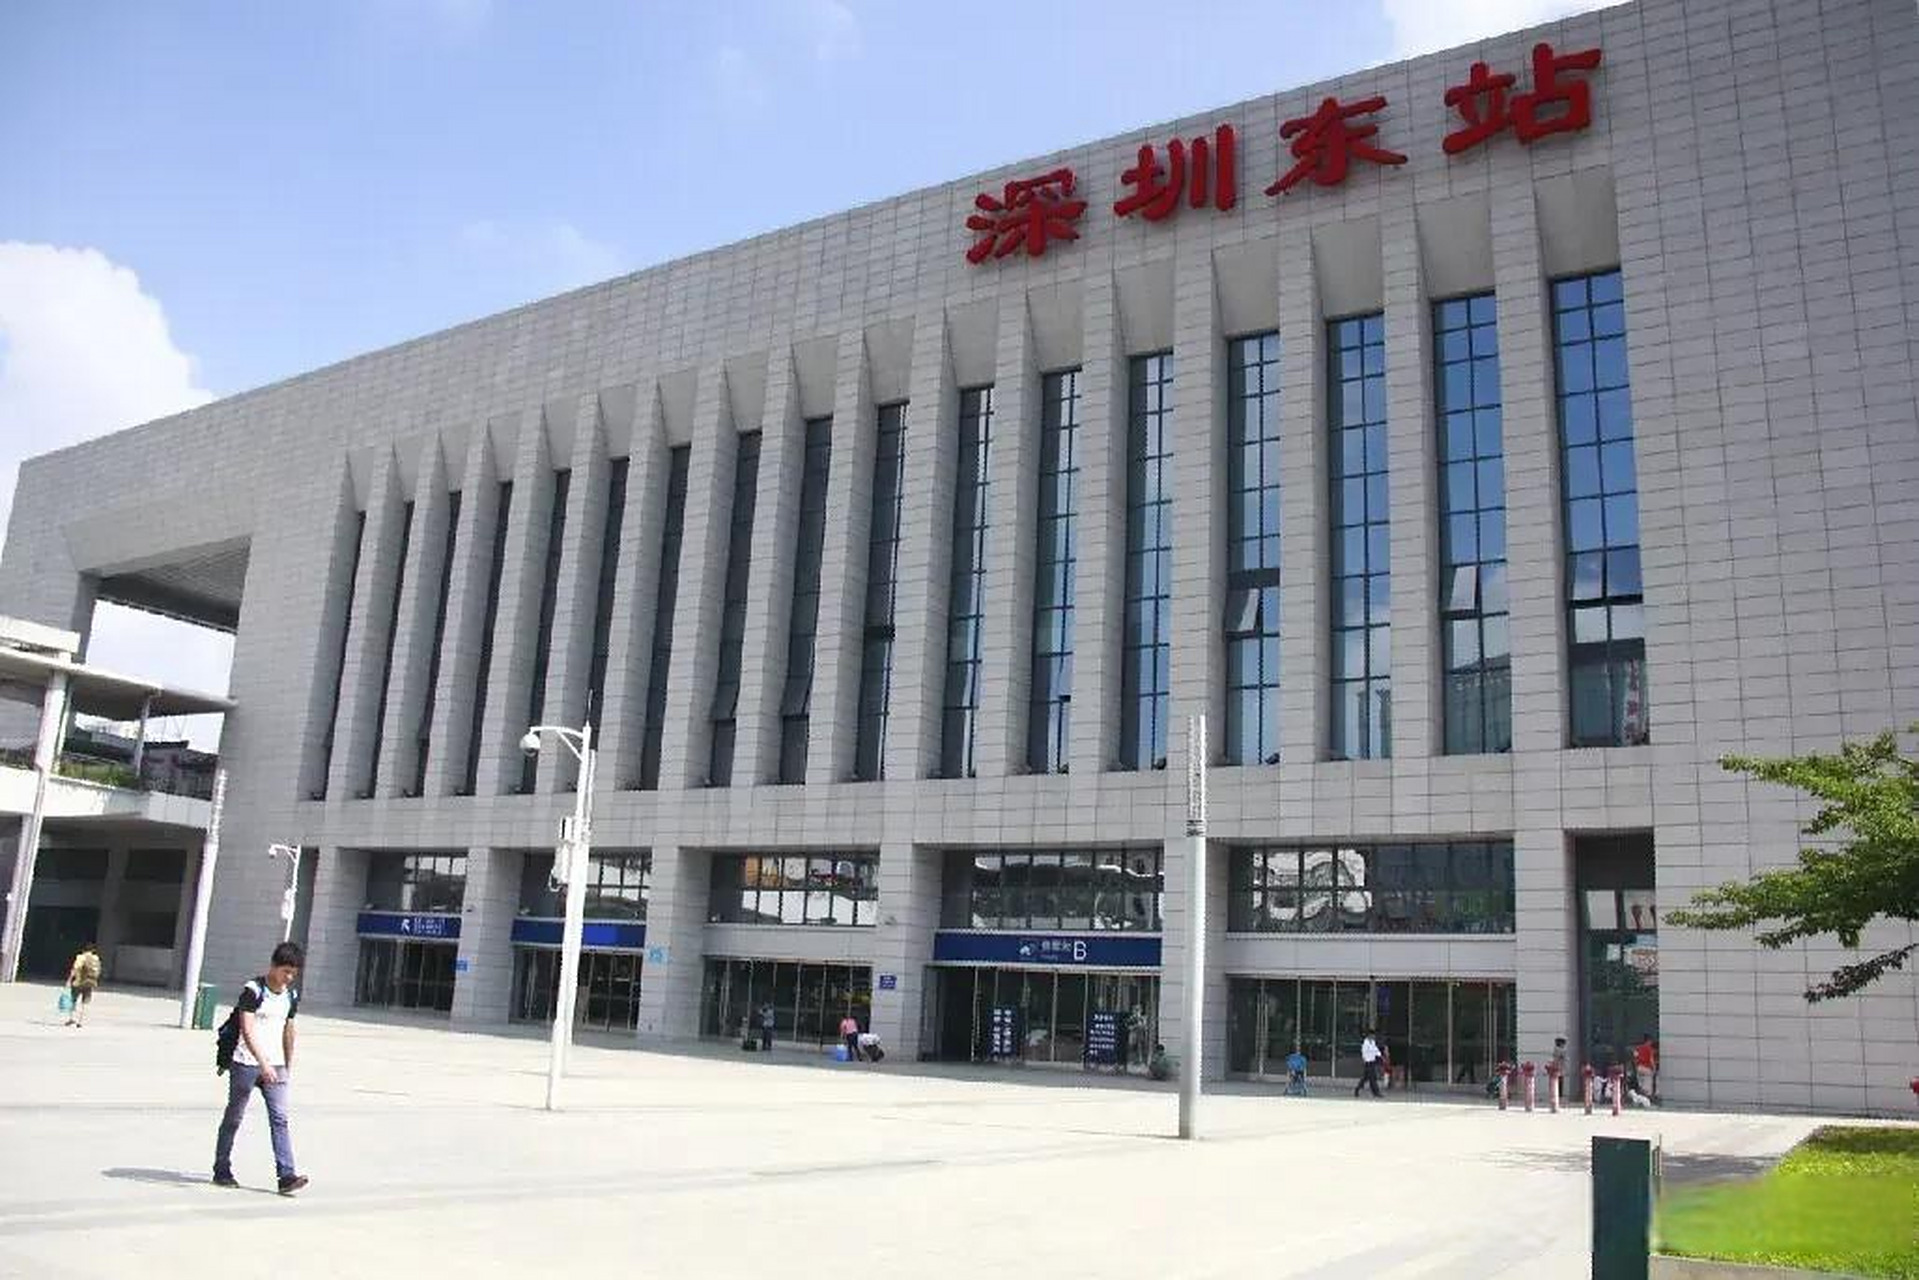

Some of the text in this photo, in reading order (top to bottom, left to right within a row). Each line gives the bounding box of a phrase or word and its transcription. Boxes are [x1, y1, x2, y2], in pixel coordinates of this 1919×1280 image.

[967, 44, 1601, 263] 深圳东站
[1073, 940, 1087, 961] B
